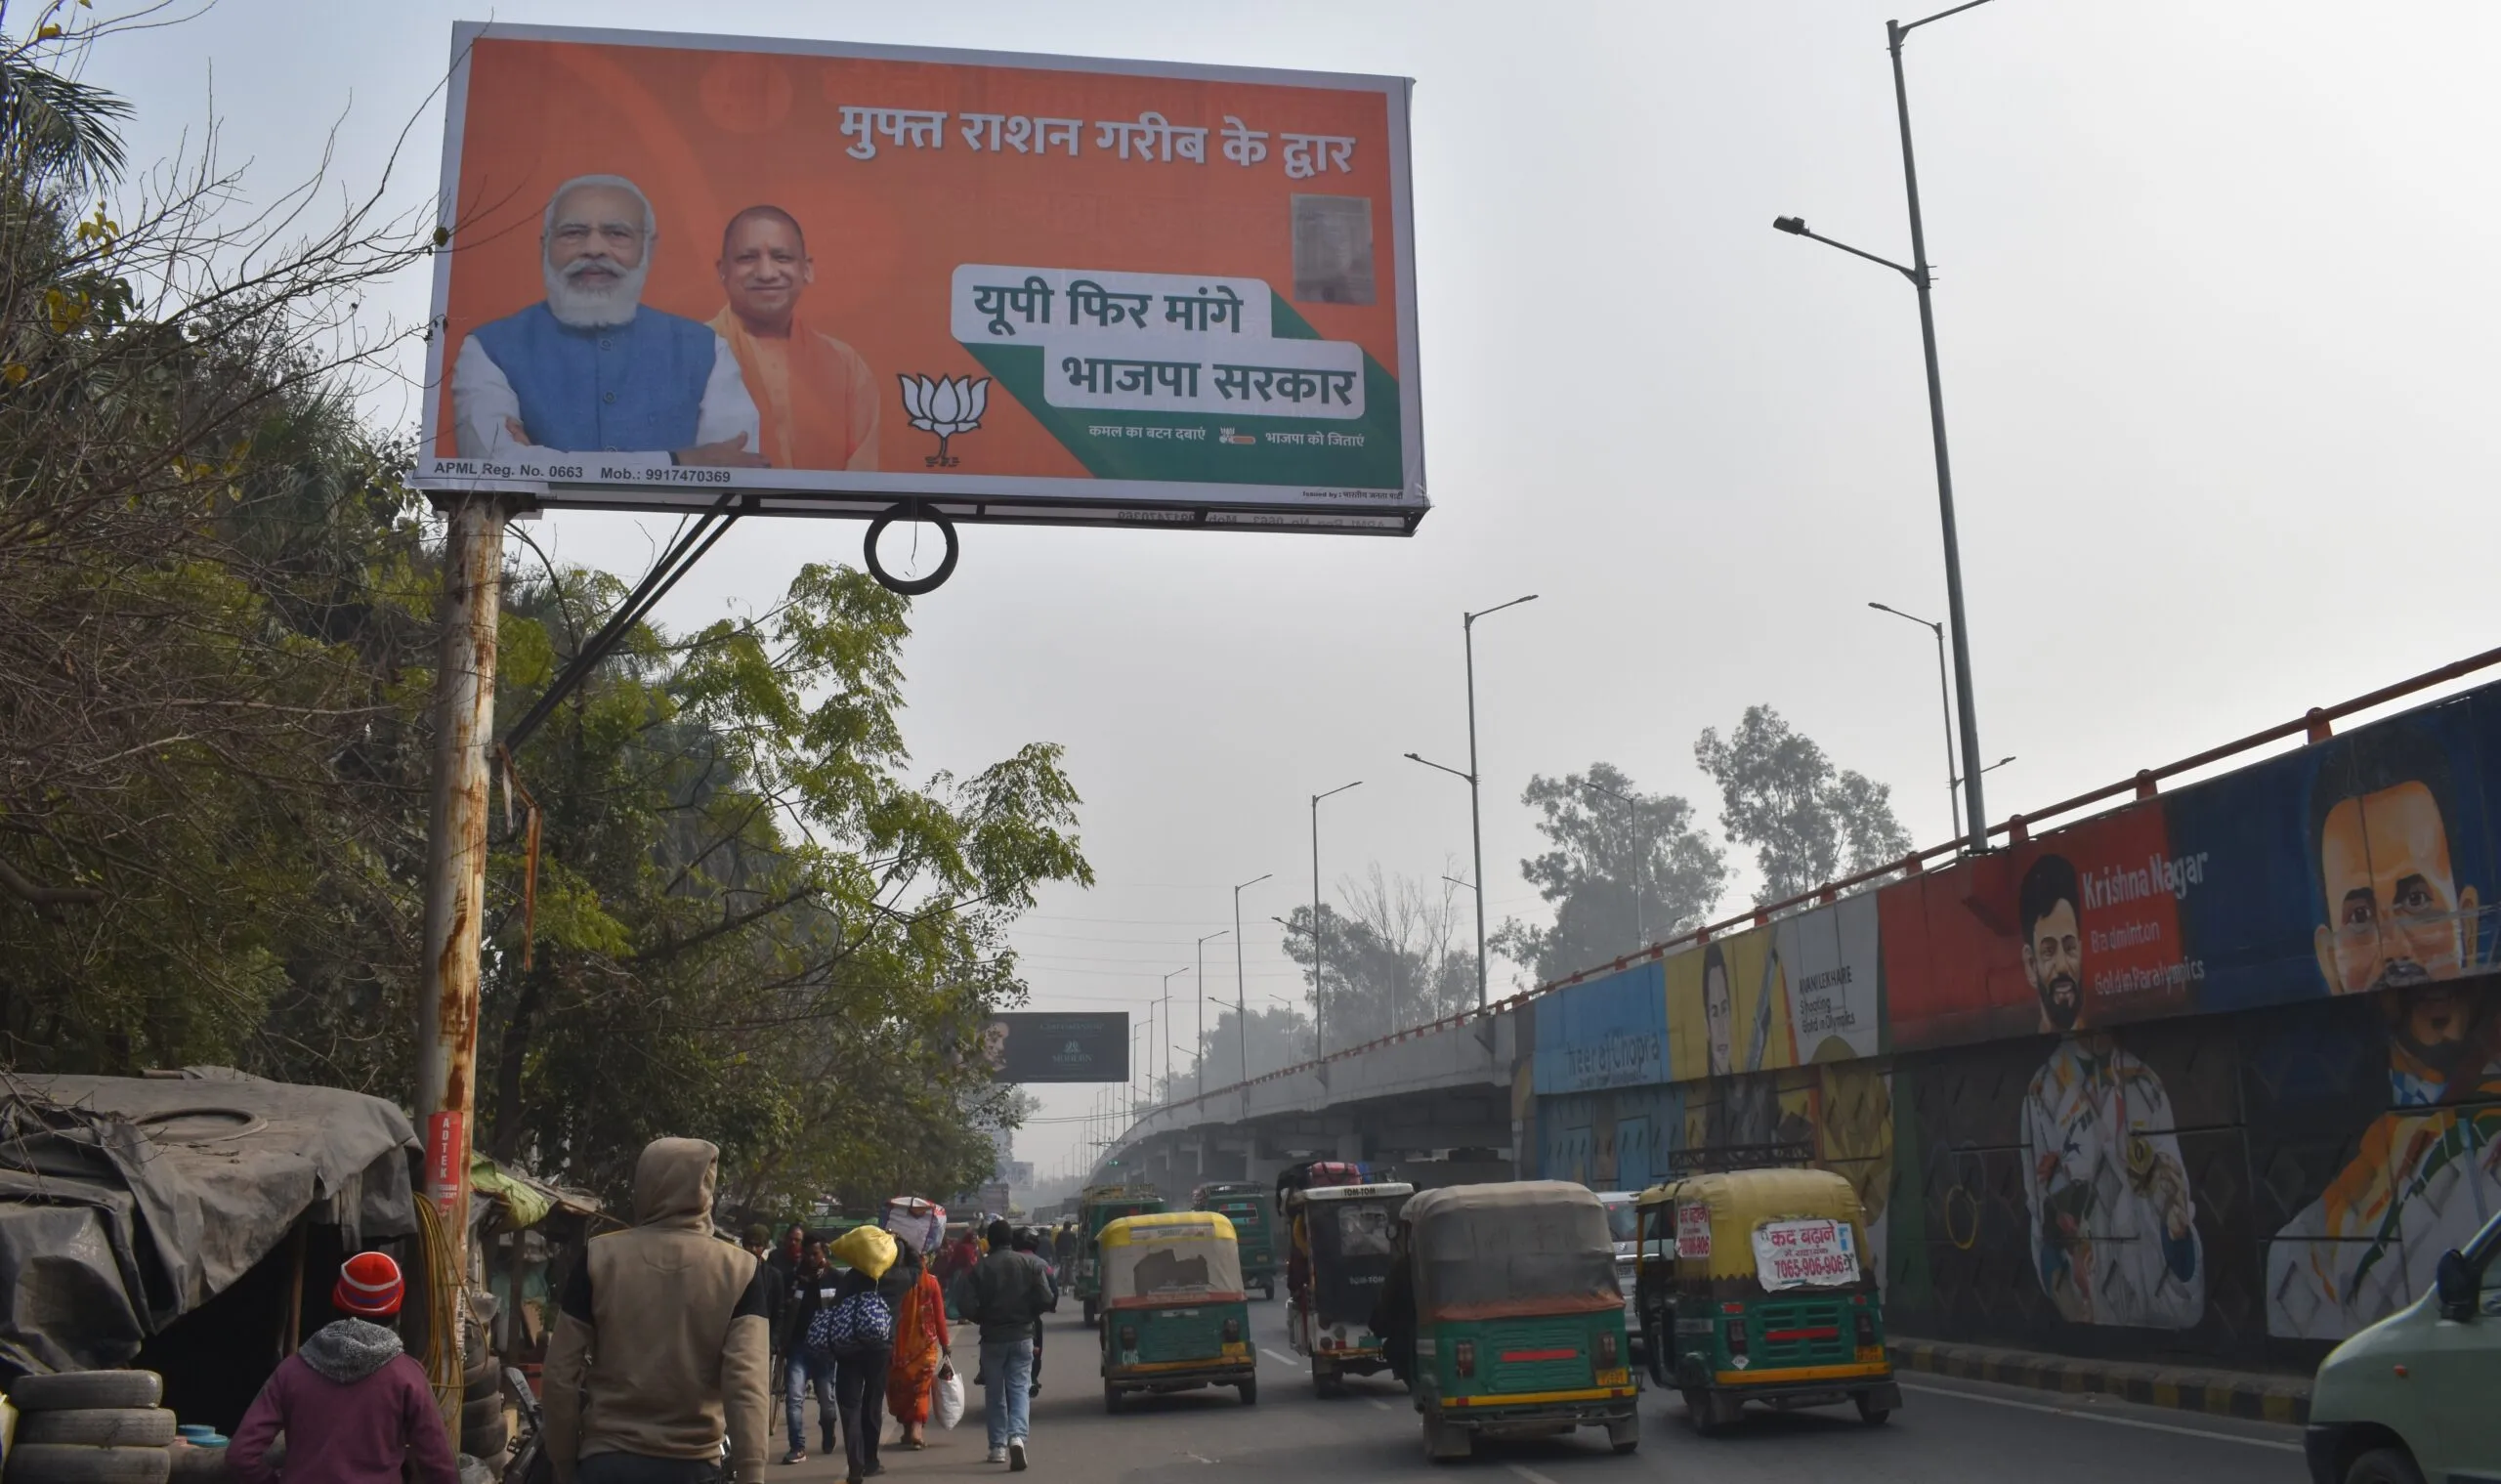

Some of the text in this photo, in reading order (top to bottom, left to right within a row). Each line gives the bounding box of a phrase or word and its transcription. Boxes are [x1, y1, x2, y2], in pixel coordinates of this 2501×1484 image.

[839, 106, 1355, 177] मुफ्त राशन गरीब के द्वार
[973, 276, 1244, 336] यूपी फिर मांगे
[1062, 357, 1356, 408] भाजपा सरकार
[1089, 425, 1206, 441] कमल का बटन दबाएं
[1265, 432, 1365, 447] भाजपा को जिताएं
[434, 462, 478, 476] APML
[483, 464, 515, 478] Reg.
[520, 464, 544, 477] No.
[549, 465, 583, 479] 0663
[646, 468, 731, 484] 9917470369
[2083, 852, 2209, 911] Krishna Nagar
[2095, 967, 2122, 995] Gold
[2133, 955, 2205, 995] Paralympics
[1611, 1031, 1660, 1072] Chopra
[441, 1117, 449, 1179] ADTEK
[1770, 1230, 1796, 1247] कद
[1349, 1276, 1384, 1285] TOM-TOM
[1774, 1254, 1844, 1279] 7065-906-906
